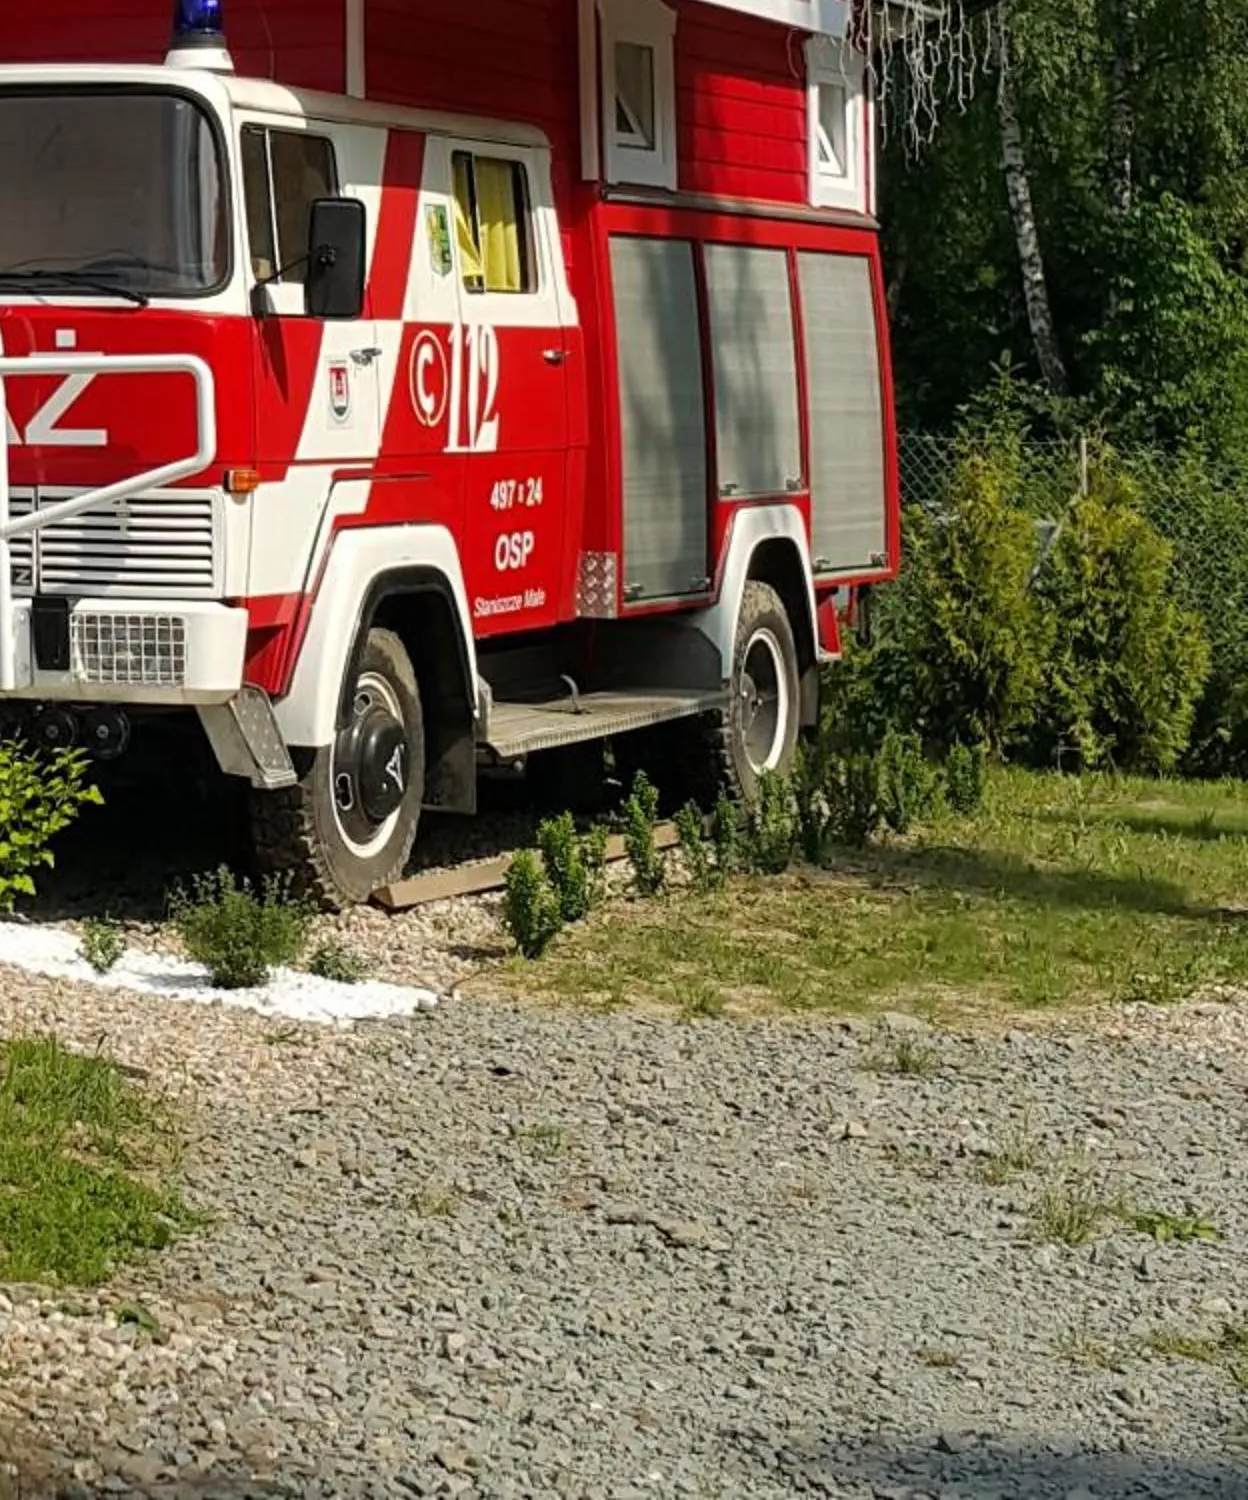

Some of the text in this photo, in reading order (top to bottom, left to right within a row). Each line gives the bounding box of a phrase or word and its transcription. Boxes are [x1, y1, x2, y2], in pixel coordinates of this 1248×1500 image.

[442, 322, 500, 453] 112
[490, 478, 517, 511] 497
[494, 530, 534, 572] OSP
